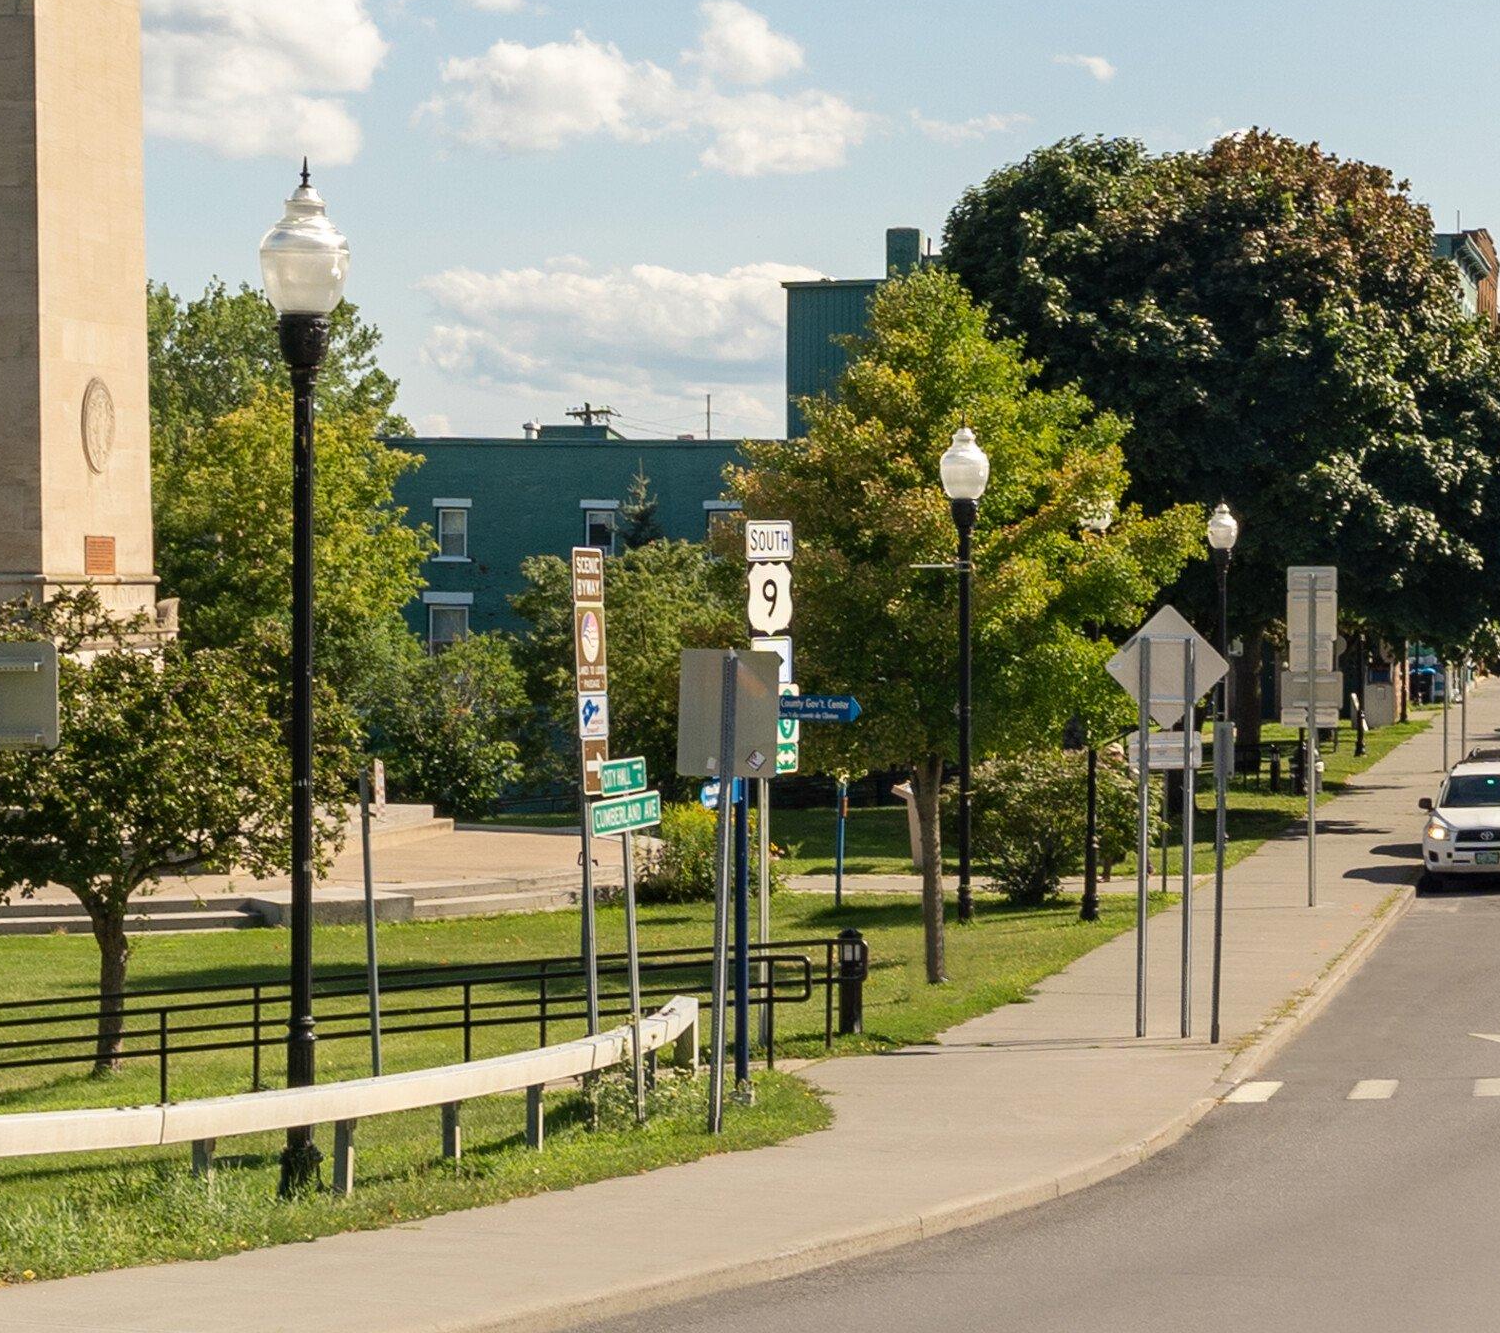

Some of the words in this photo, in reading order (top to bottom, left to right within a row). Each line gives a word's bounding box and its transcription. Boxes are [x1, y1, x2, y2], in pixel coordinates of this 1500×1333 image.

[750, 529, 788, 551] SOUTH
[576, 556, 600, 574] SCENIC
[577, 578, 600, 596] BYWAY
[762, 579, 778, 618] 9
[780, 698, 804, 710] County
[827, 699, 849, 710] Center
[604, 769, 617, 789] CITY
[617, 767, 632, 786] HALL
[595, 802, 642, 828] CUMBERLAND
[644, 799, 657, 819] AVE
